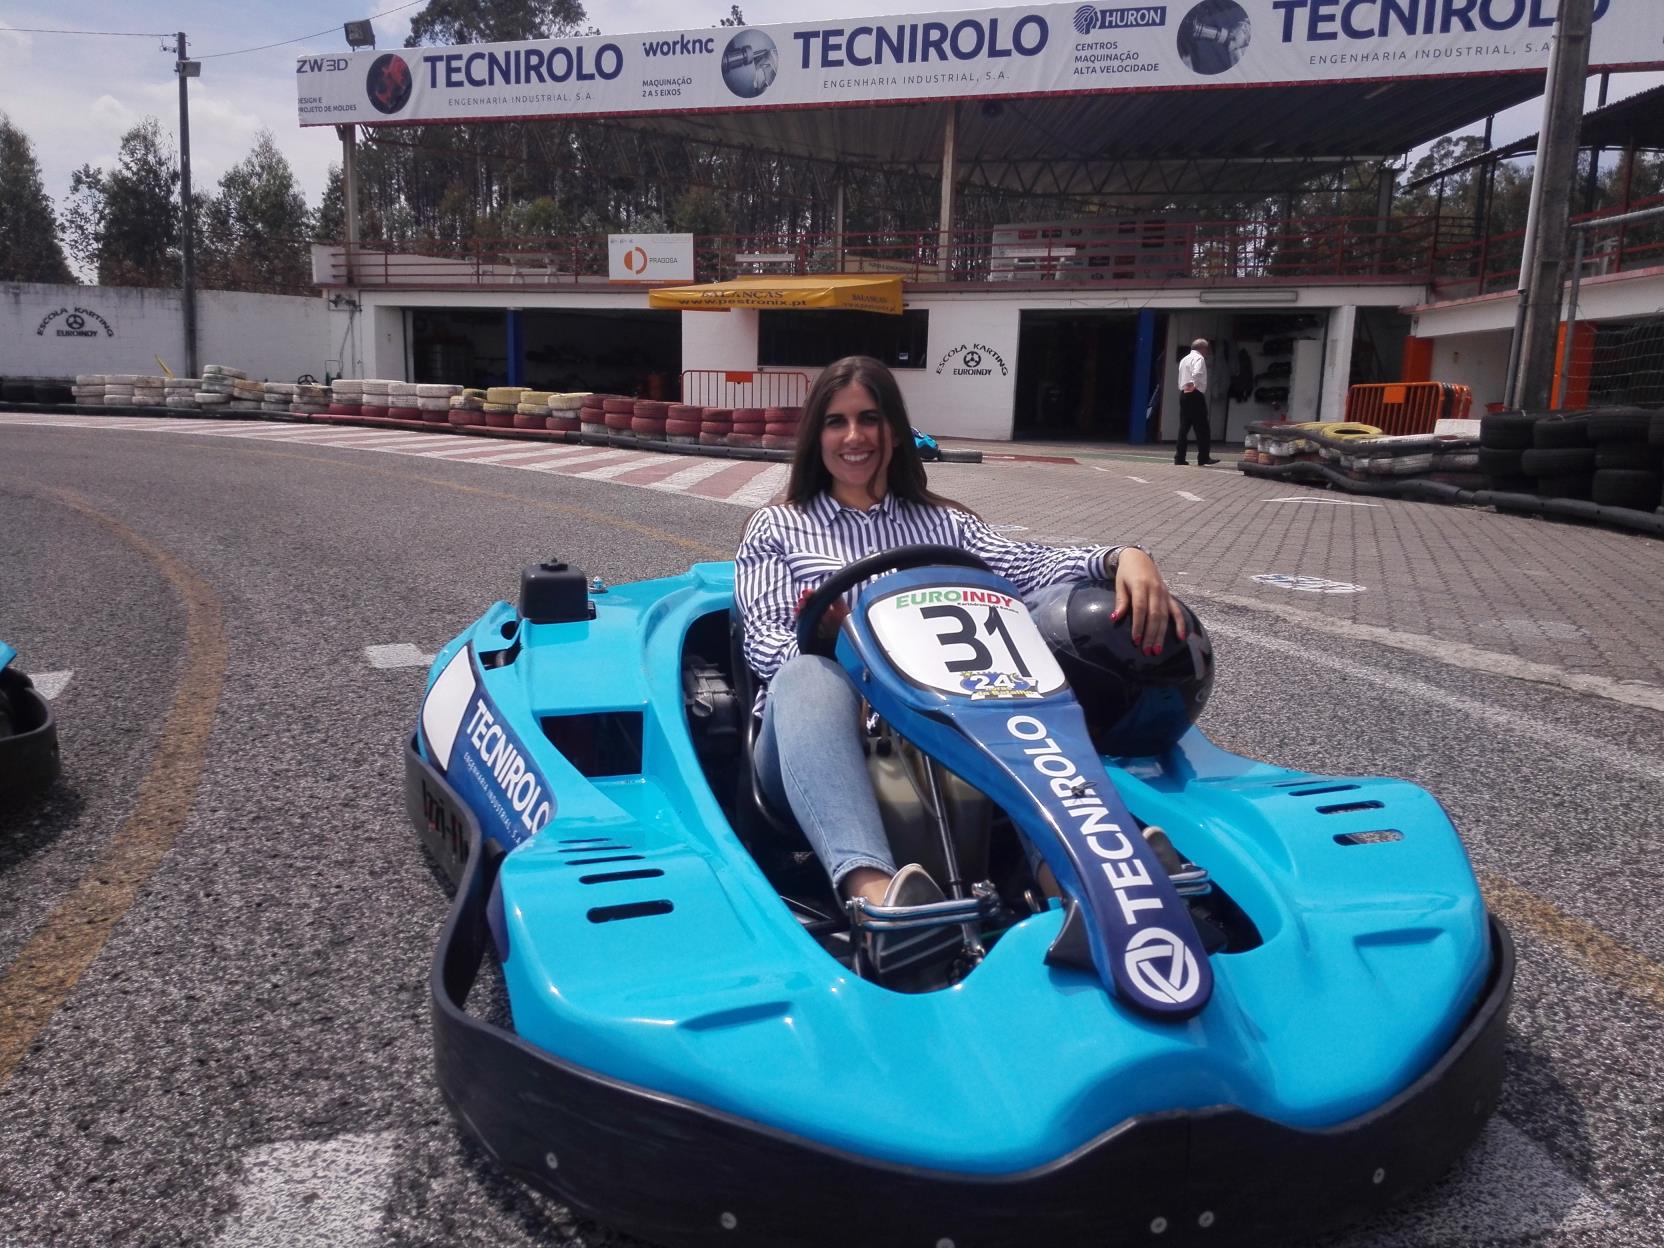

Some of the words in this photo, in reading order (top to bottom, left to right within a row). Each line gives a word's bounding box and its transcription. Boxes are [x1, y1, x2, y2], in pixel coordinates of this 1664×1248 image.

[1105, 9, 1160, 26] HURON
[1272, 0, 1610, 42] TECNIROL
[642, 34, 714, 57] worknc
[793, 14, 1049, 69] TECNIROLO
[1075, 41, 1118, 51] CENTROS
[1074, 51, 1139, 63] MAQUINAÇÃO
[1309, 51, 1407, 64] ENGENHARIA
[1415, 44, 1516, 59] INDUSTRIAL,
[296, 58, 349, 73] ZW3D
[423, 43, 624, 88] TECNIROLO
[1073, 66, 1097, 75] ALTA
[1099, 63, 1159, 74] VELOCIDADE
[642, 77, 693, 87] MAQUINAÇÃO
[823, 77, 897, 88] ENGENHARIA
[903, 73, 979, 84] INDUSTRIAL,
[986, 71, 1009, 81] S.A.
[448, 97, 507, 106] ENGENHARIA
[660, 89, 681, 97] EIXOS
[333, 104, 357, 112] MOLDES
[37, 307, 68, 337] ESCOLA
[74, 306, 115, 338] KARTING
[56, 329, 98, 337] EUROINDY
[936, 344, 967, 374] ESCOLA
[973, 343, 1009, 376] KARTING
[953, 368, 993, 376] EUROINDY
[896, 590, 1014, 609] EUROINDY
[920, 604, 1032, 677] 31
[969, 674, 1015, 690] 24
[466, 698, 550, 835] TECNIROLO
[1006, 714, 1164, 925] TECNIROLO
